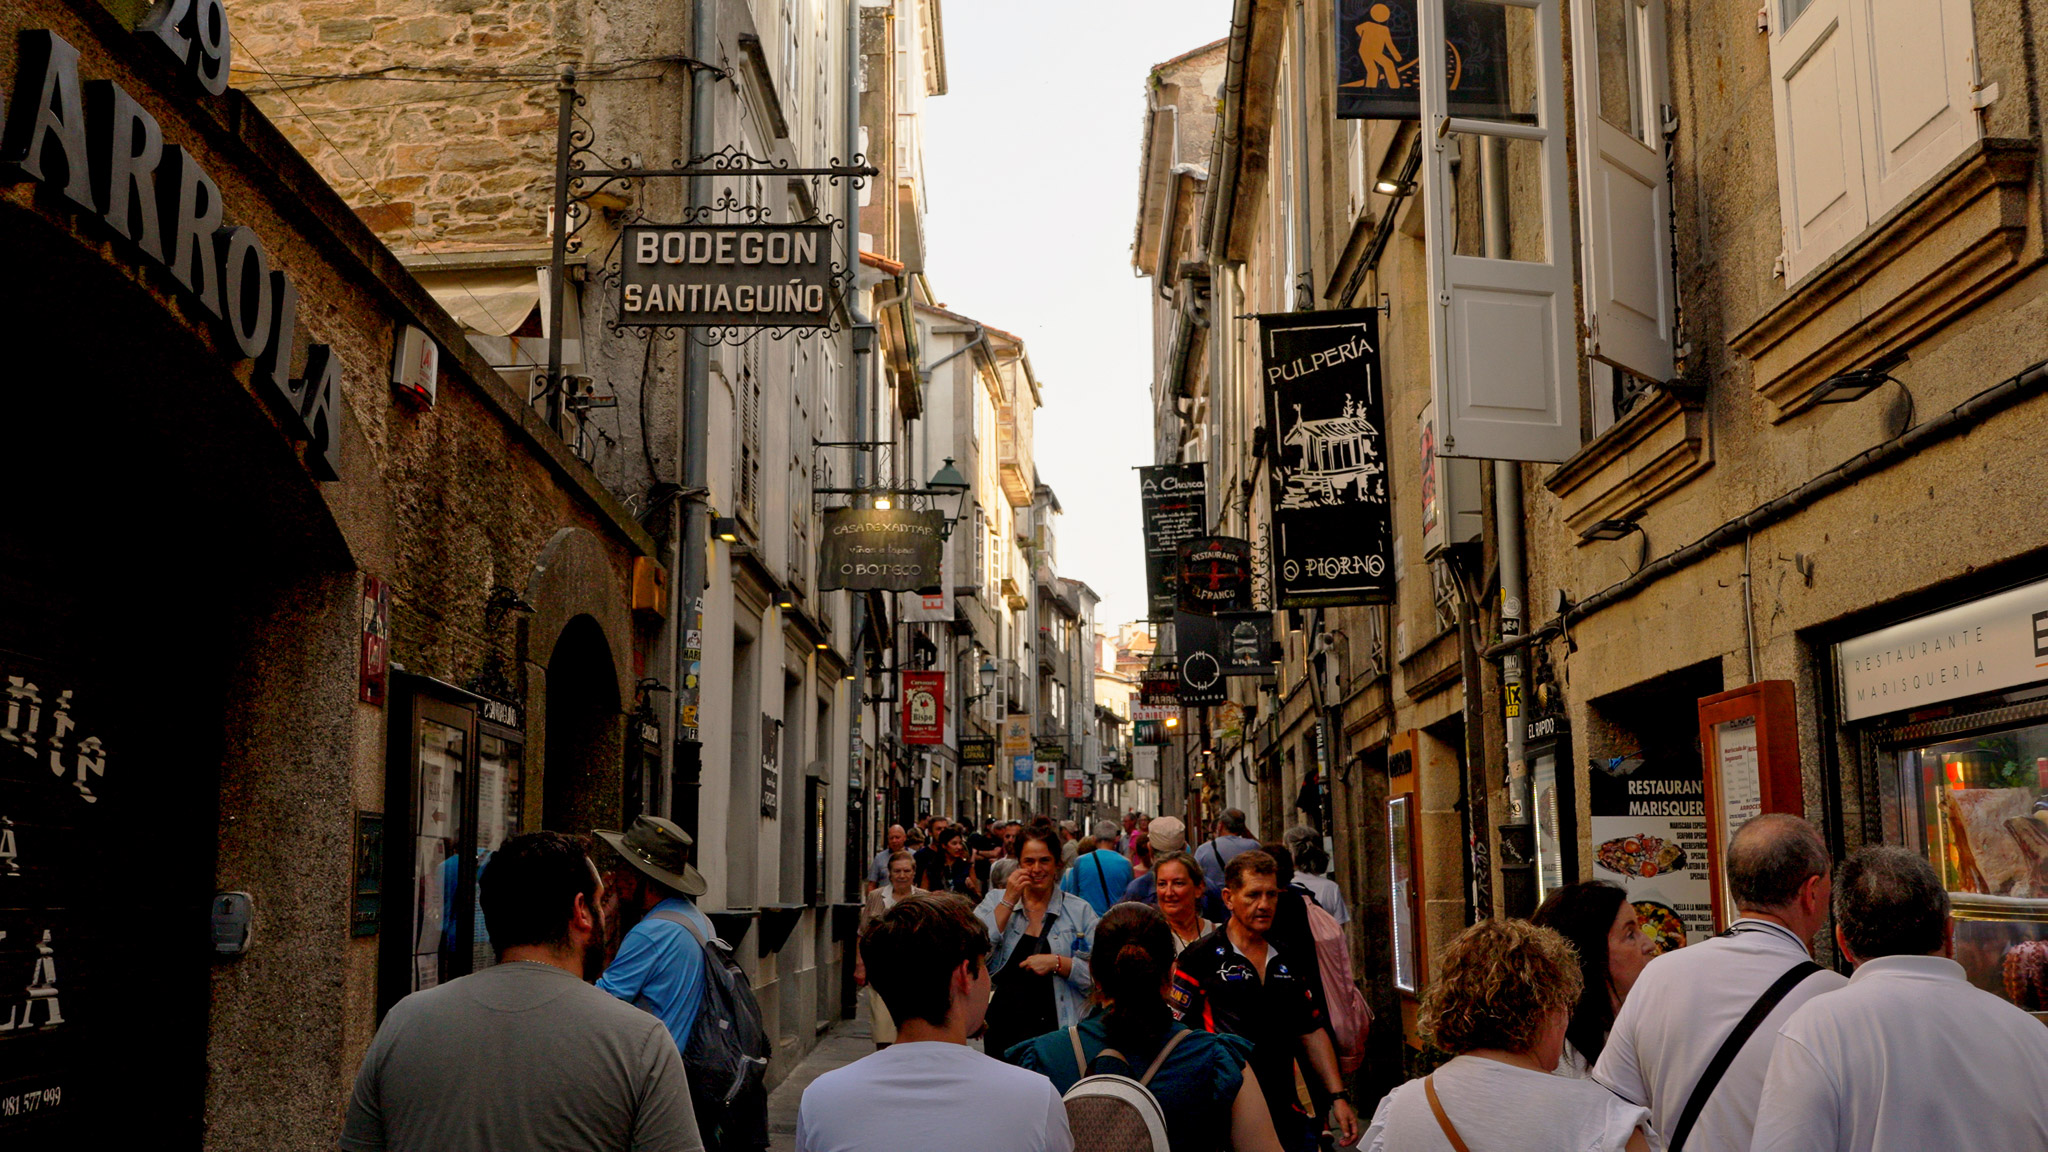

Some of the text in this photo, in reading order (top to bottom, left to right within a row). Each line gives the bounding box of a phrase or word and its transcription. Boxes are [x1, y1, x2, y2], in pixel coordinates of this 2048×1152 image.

[0, 29, 341, 482] ARROLA
[636, 232, 817, 264] BODEGON
[624, 278, 823, 312] SANTIAGUIÑO
[1267, 335, 1373, 385] PULPERÍA
[1142, 477, 1205, 492] A Charca
[1191, 551, 1240, 562] RESTAURANTE
[1283, 554, 1385, 581] O PIORNO
[1201, 588, 1236, 600] FRANCO
[1855, 626, 1982, 673] RESTAURANTE
[1857, 659, 1985, 702] MARISQUERÍA
[1627, 779, 1704, 796] RESTAURAN
[1628, 800, 1705, 816] MARISQUER
